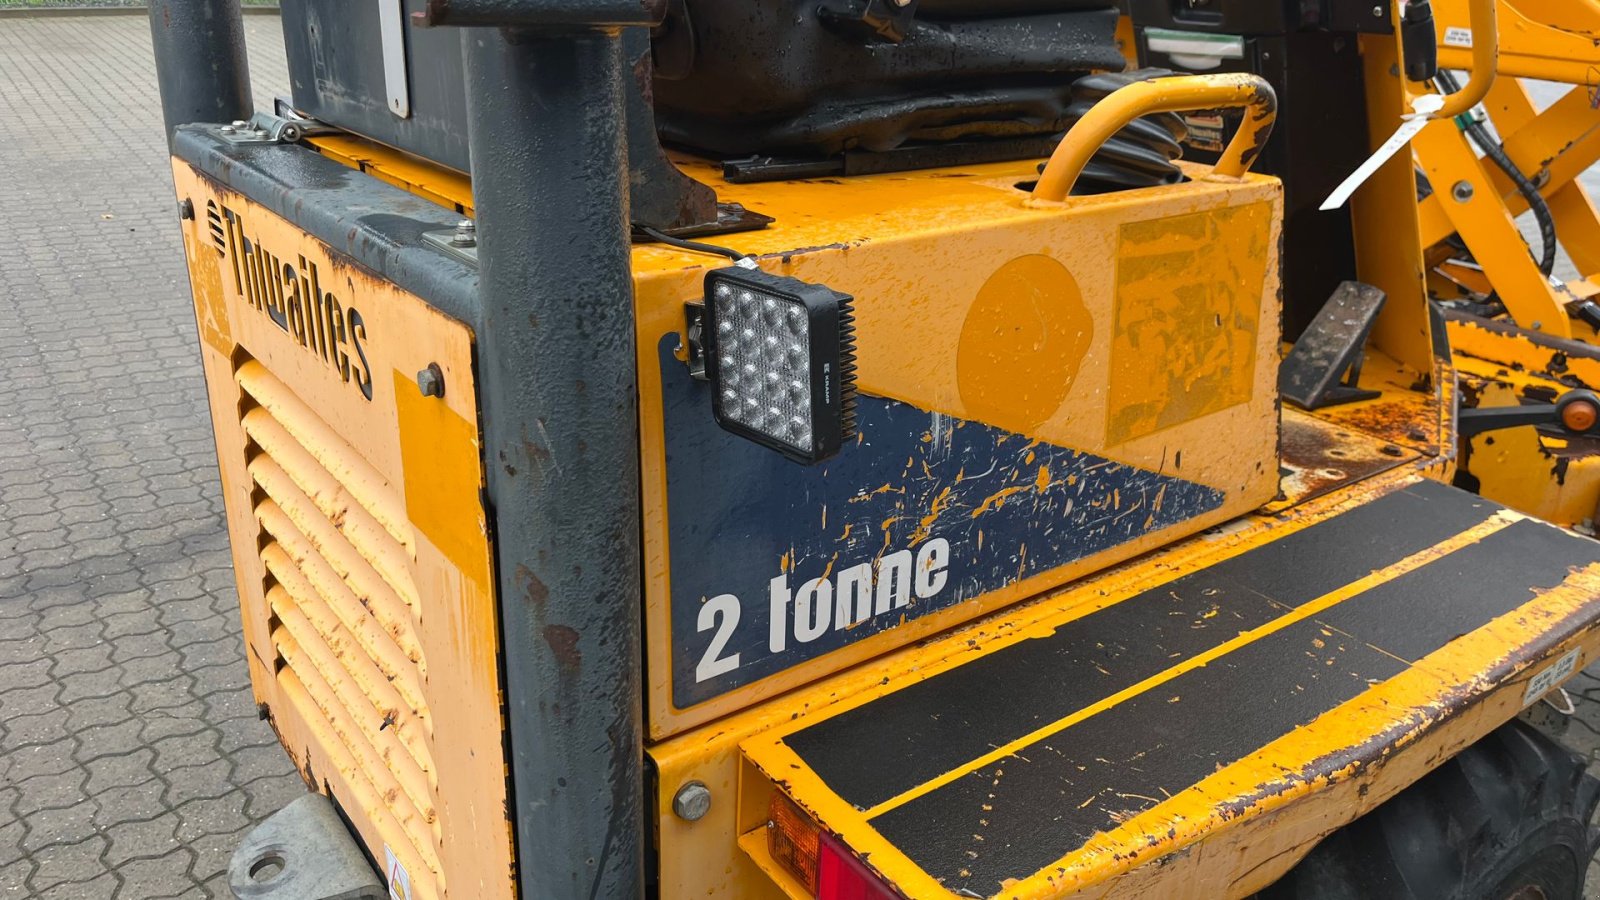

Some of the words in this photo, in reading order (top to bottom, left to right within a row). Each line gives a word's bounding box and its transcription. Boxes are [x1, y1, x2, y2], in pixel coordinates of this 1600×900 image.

[220, 204, 373, 401] Thwaites
[696, 593, 741, 683] 2
[769, 537, 950, 653] tonne
